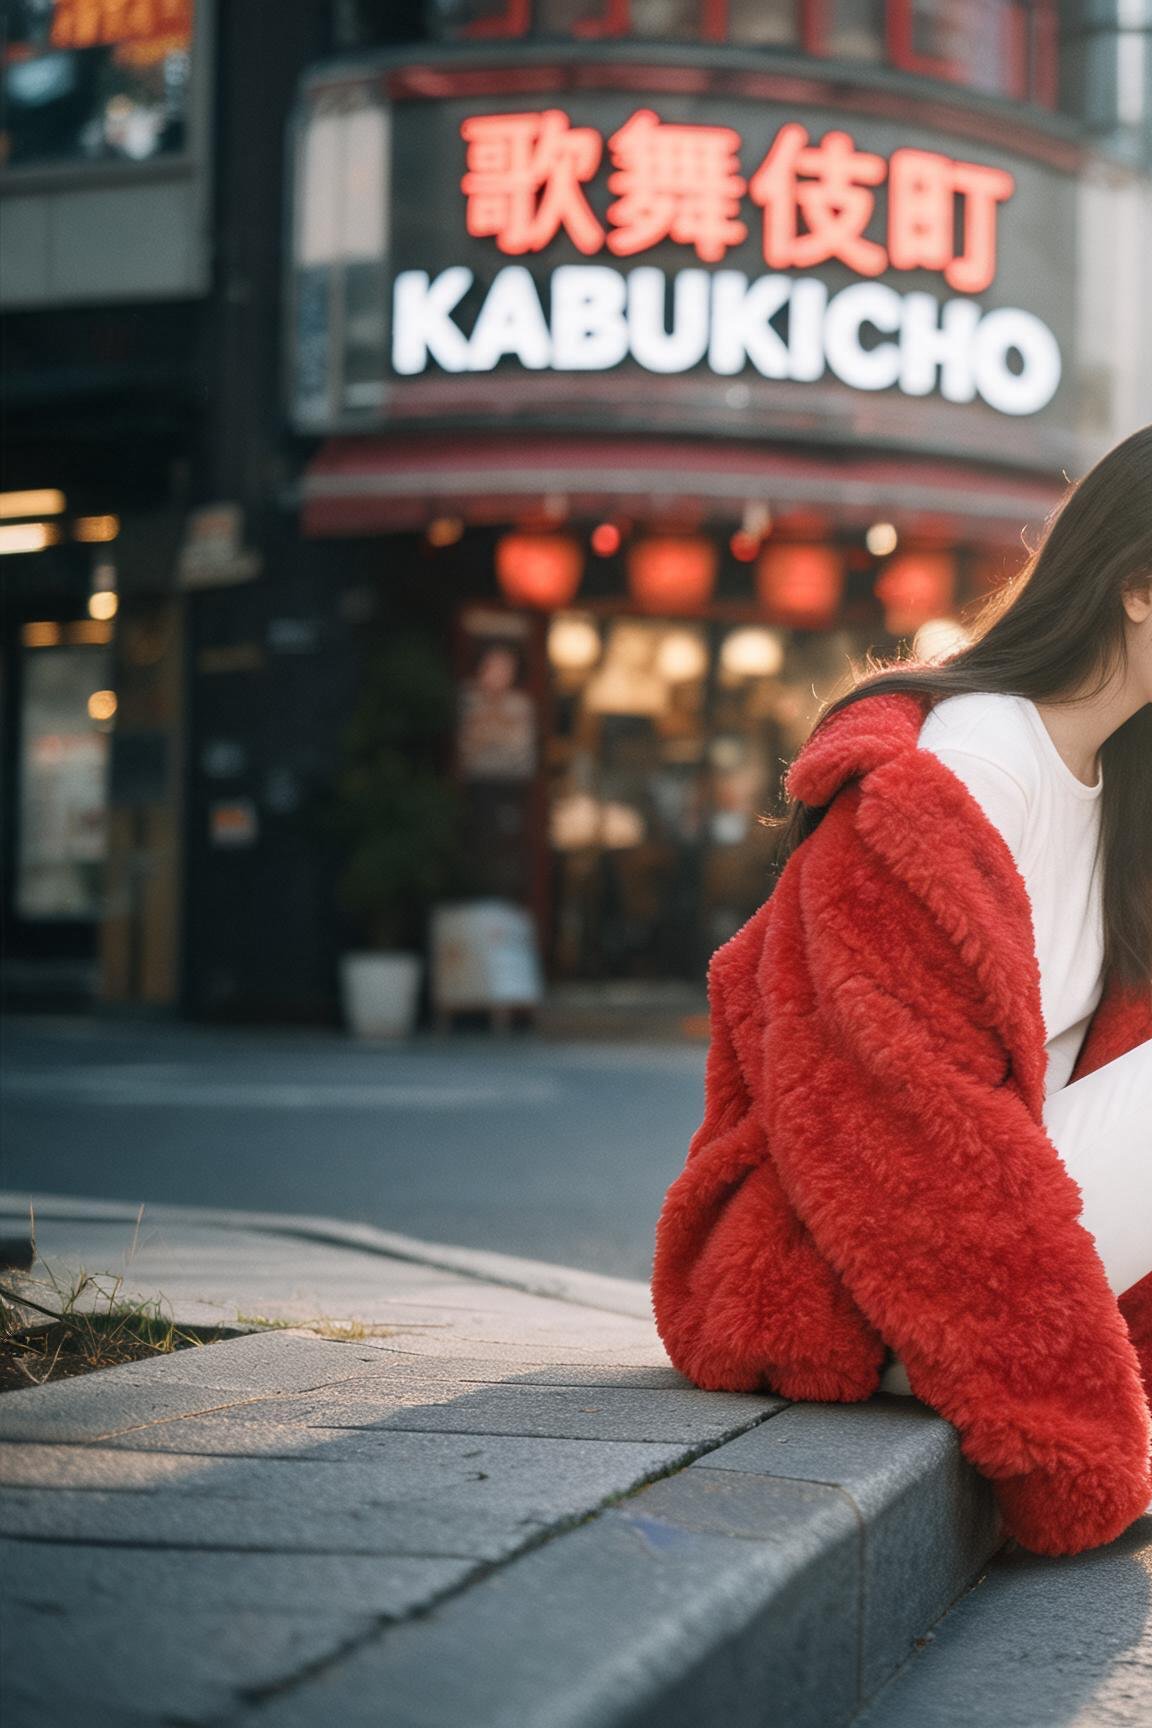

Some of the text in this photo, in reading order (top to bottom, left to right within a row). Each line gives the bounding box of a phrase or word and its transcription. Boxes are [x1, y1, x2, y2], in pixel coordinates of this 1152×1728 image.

[462, 110, 1015, 293] 歌舞伎町
[392, 265, 1062, 415] KABUKICHO
